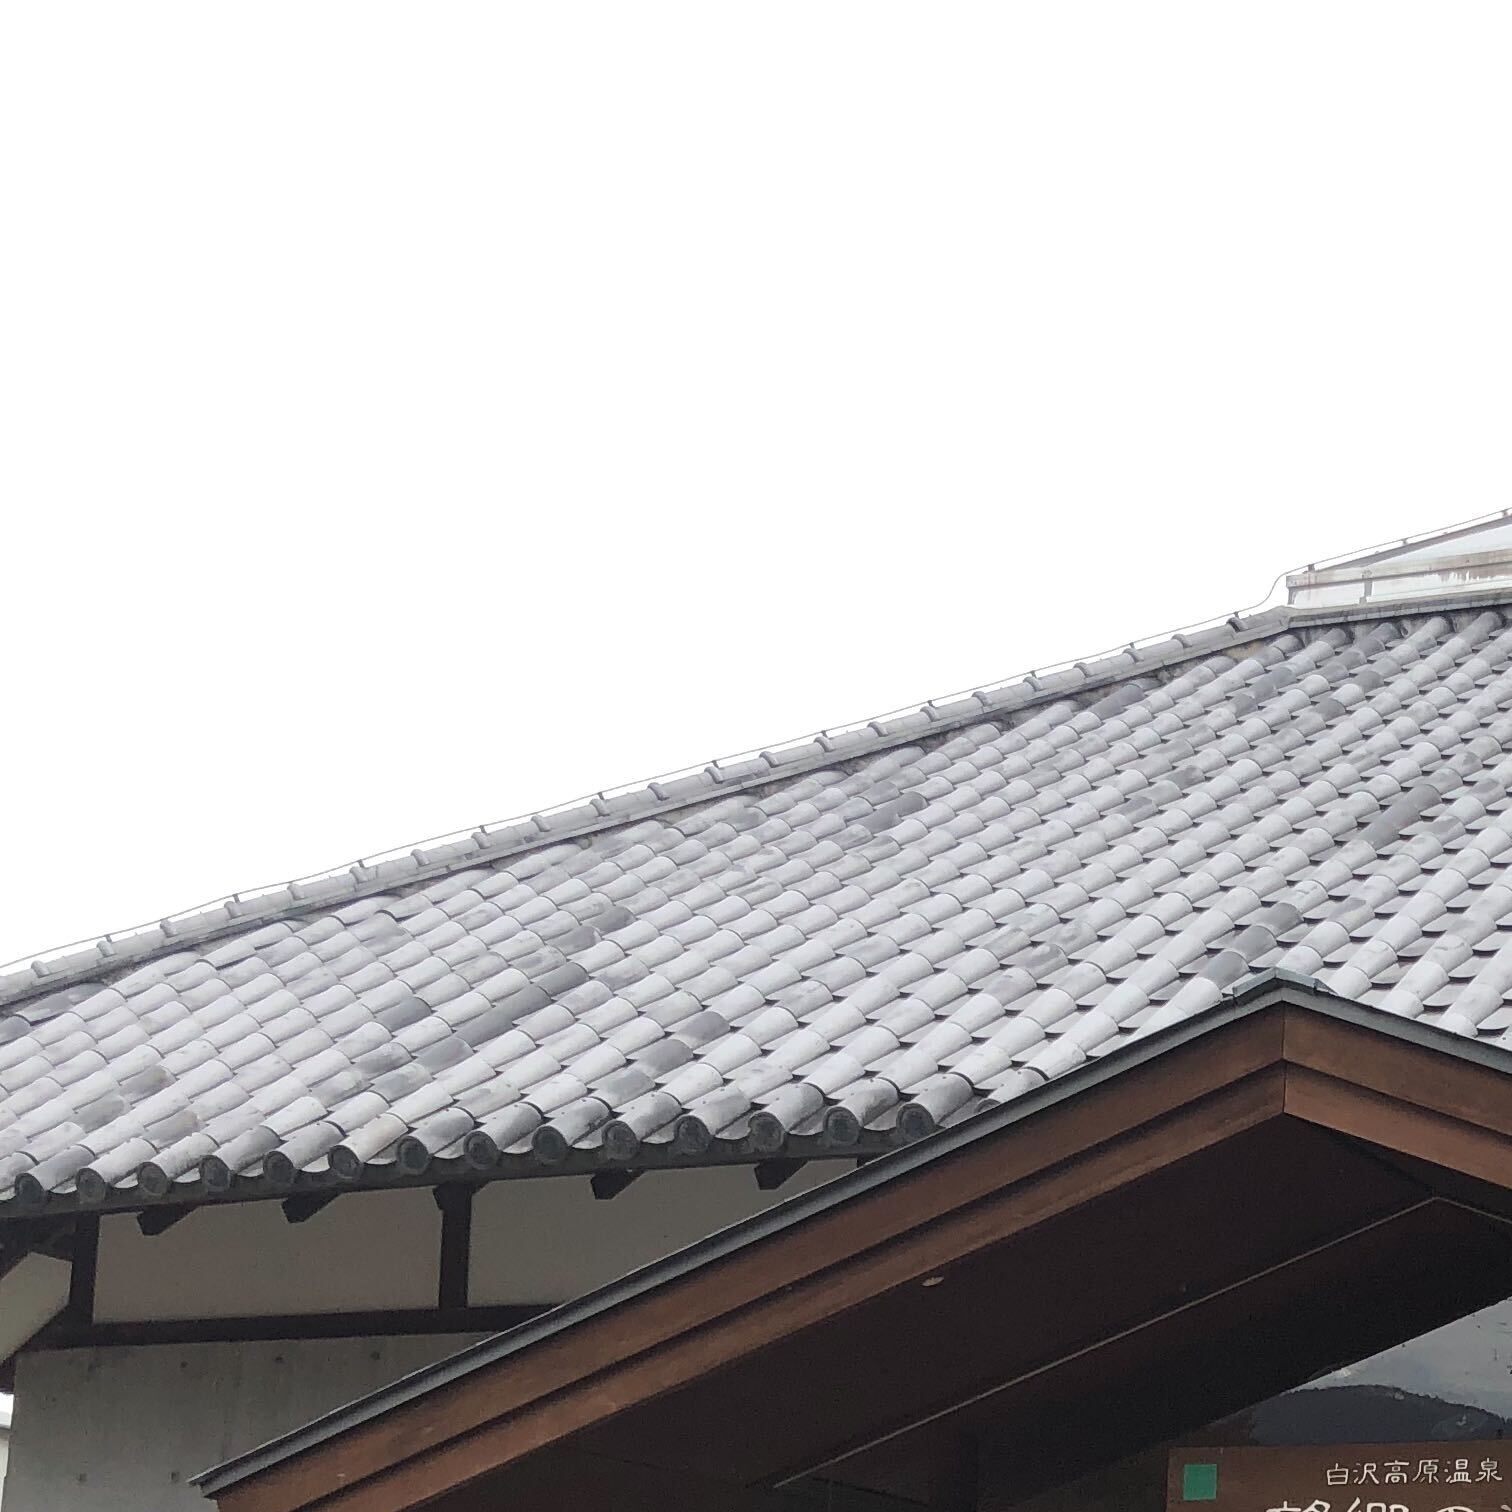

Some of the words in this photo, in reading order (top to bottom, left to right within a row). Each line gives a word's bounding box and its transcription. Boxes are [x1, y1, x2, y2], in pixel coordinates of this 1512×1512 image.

[1326, 1457, 1503, 1486] 白沢高原温泉
